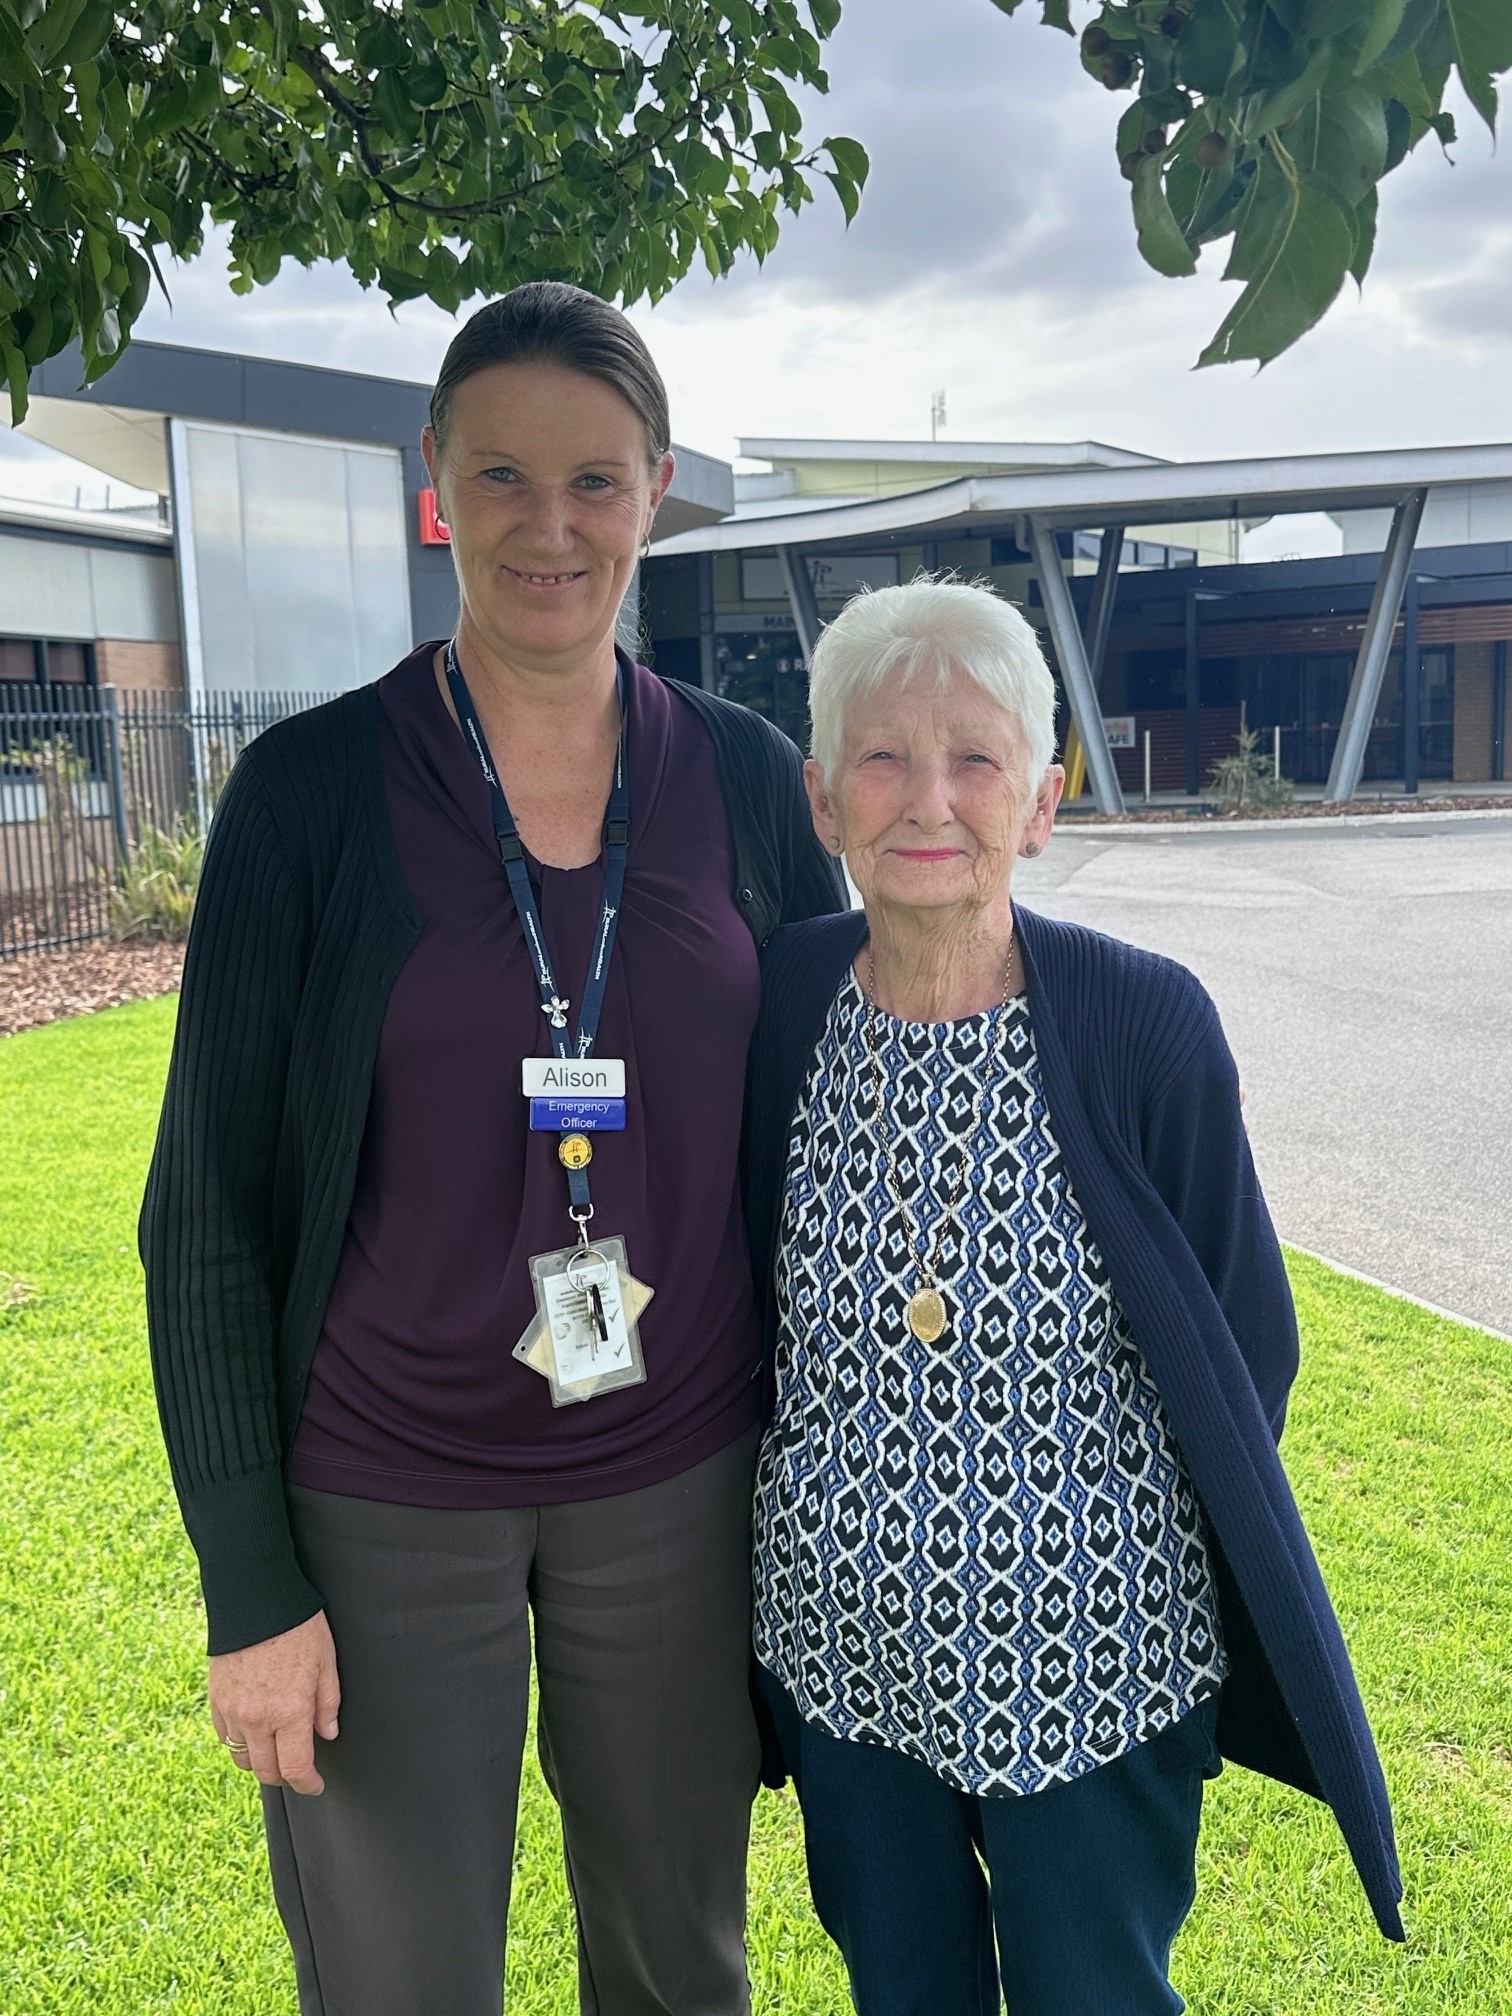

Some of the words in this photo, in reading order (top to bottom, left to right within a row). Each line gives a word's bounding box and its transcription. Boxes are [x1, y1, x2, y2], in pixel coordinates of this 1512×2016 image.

[1106, 734, 1130, 745] AFE
[543, 1067, 607, 1087] Alison
[549, 1100, 610, 1114] Emergency
[561, 1117, 597, 1128] Officer
